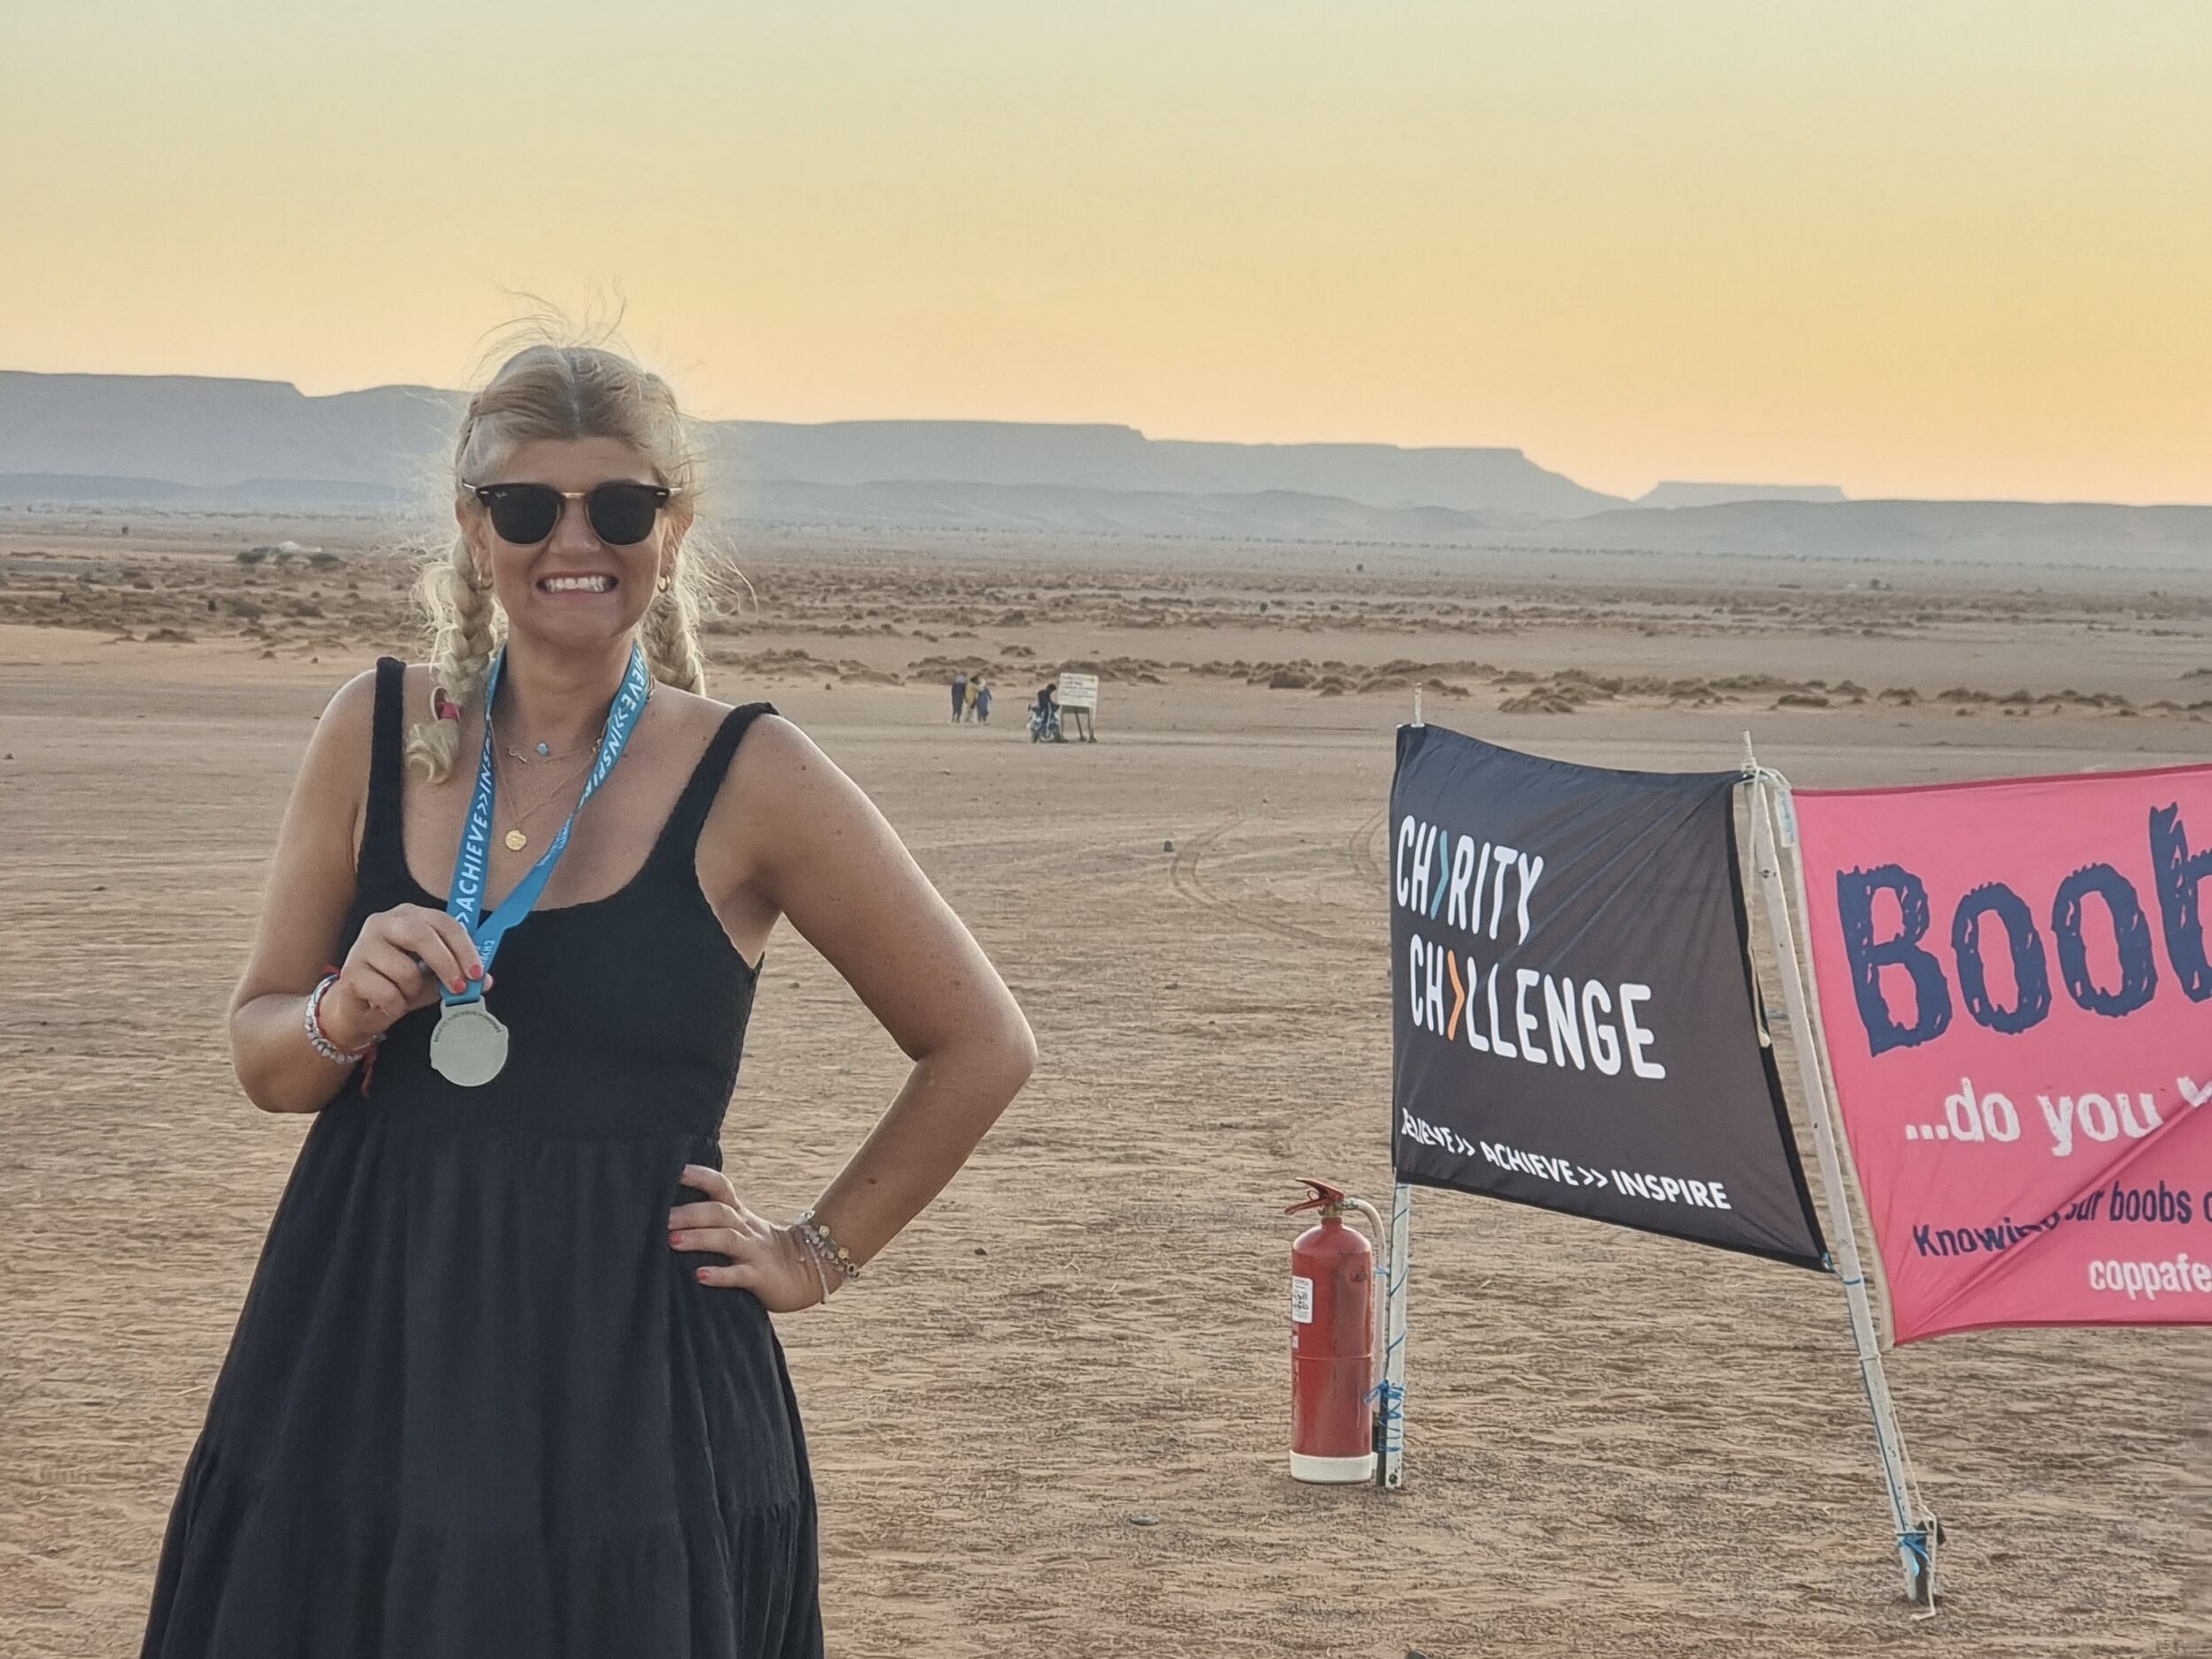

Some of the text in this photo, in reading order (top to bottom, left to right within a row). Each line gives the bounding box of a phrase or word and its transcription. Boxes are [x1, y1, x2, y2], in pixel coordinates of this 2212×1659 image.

[455, 812, 488, 913] ACHIEVE
[2037, 1092, 2163, 1157] you
[1479, 1141, 1579, 1187] ACHIEVE
[1610, 1169, 1732, 1210] INSPIRE
[2109, 1179, 2193, 1225] boobs
